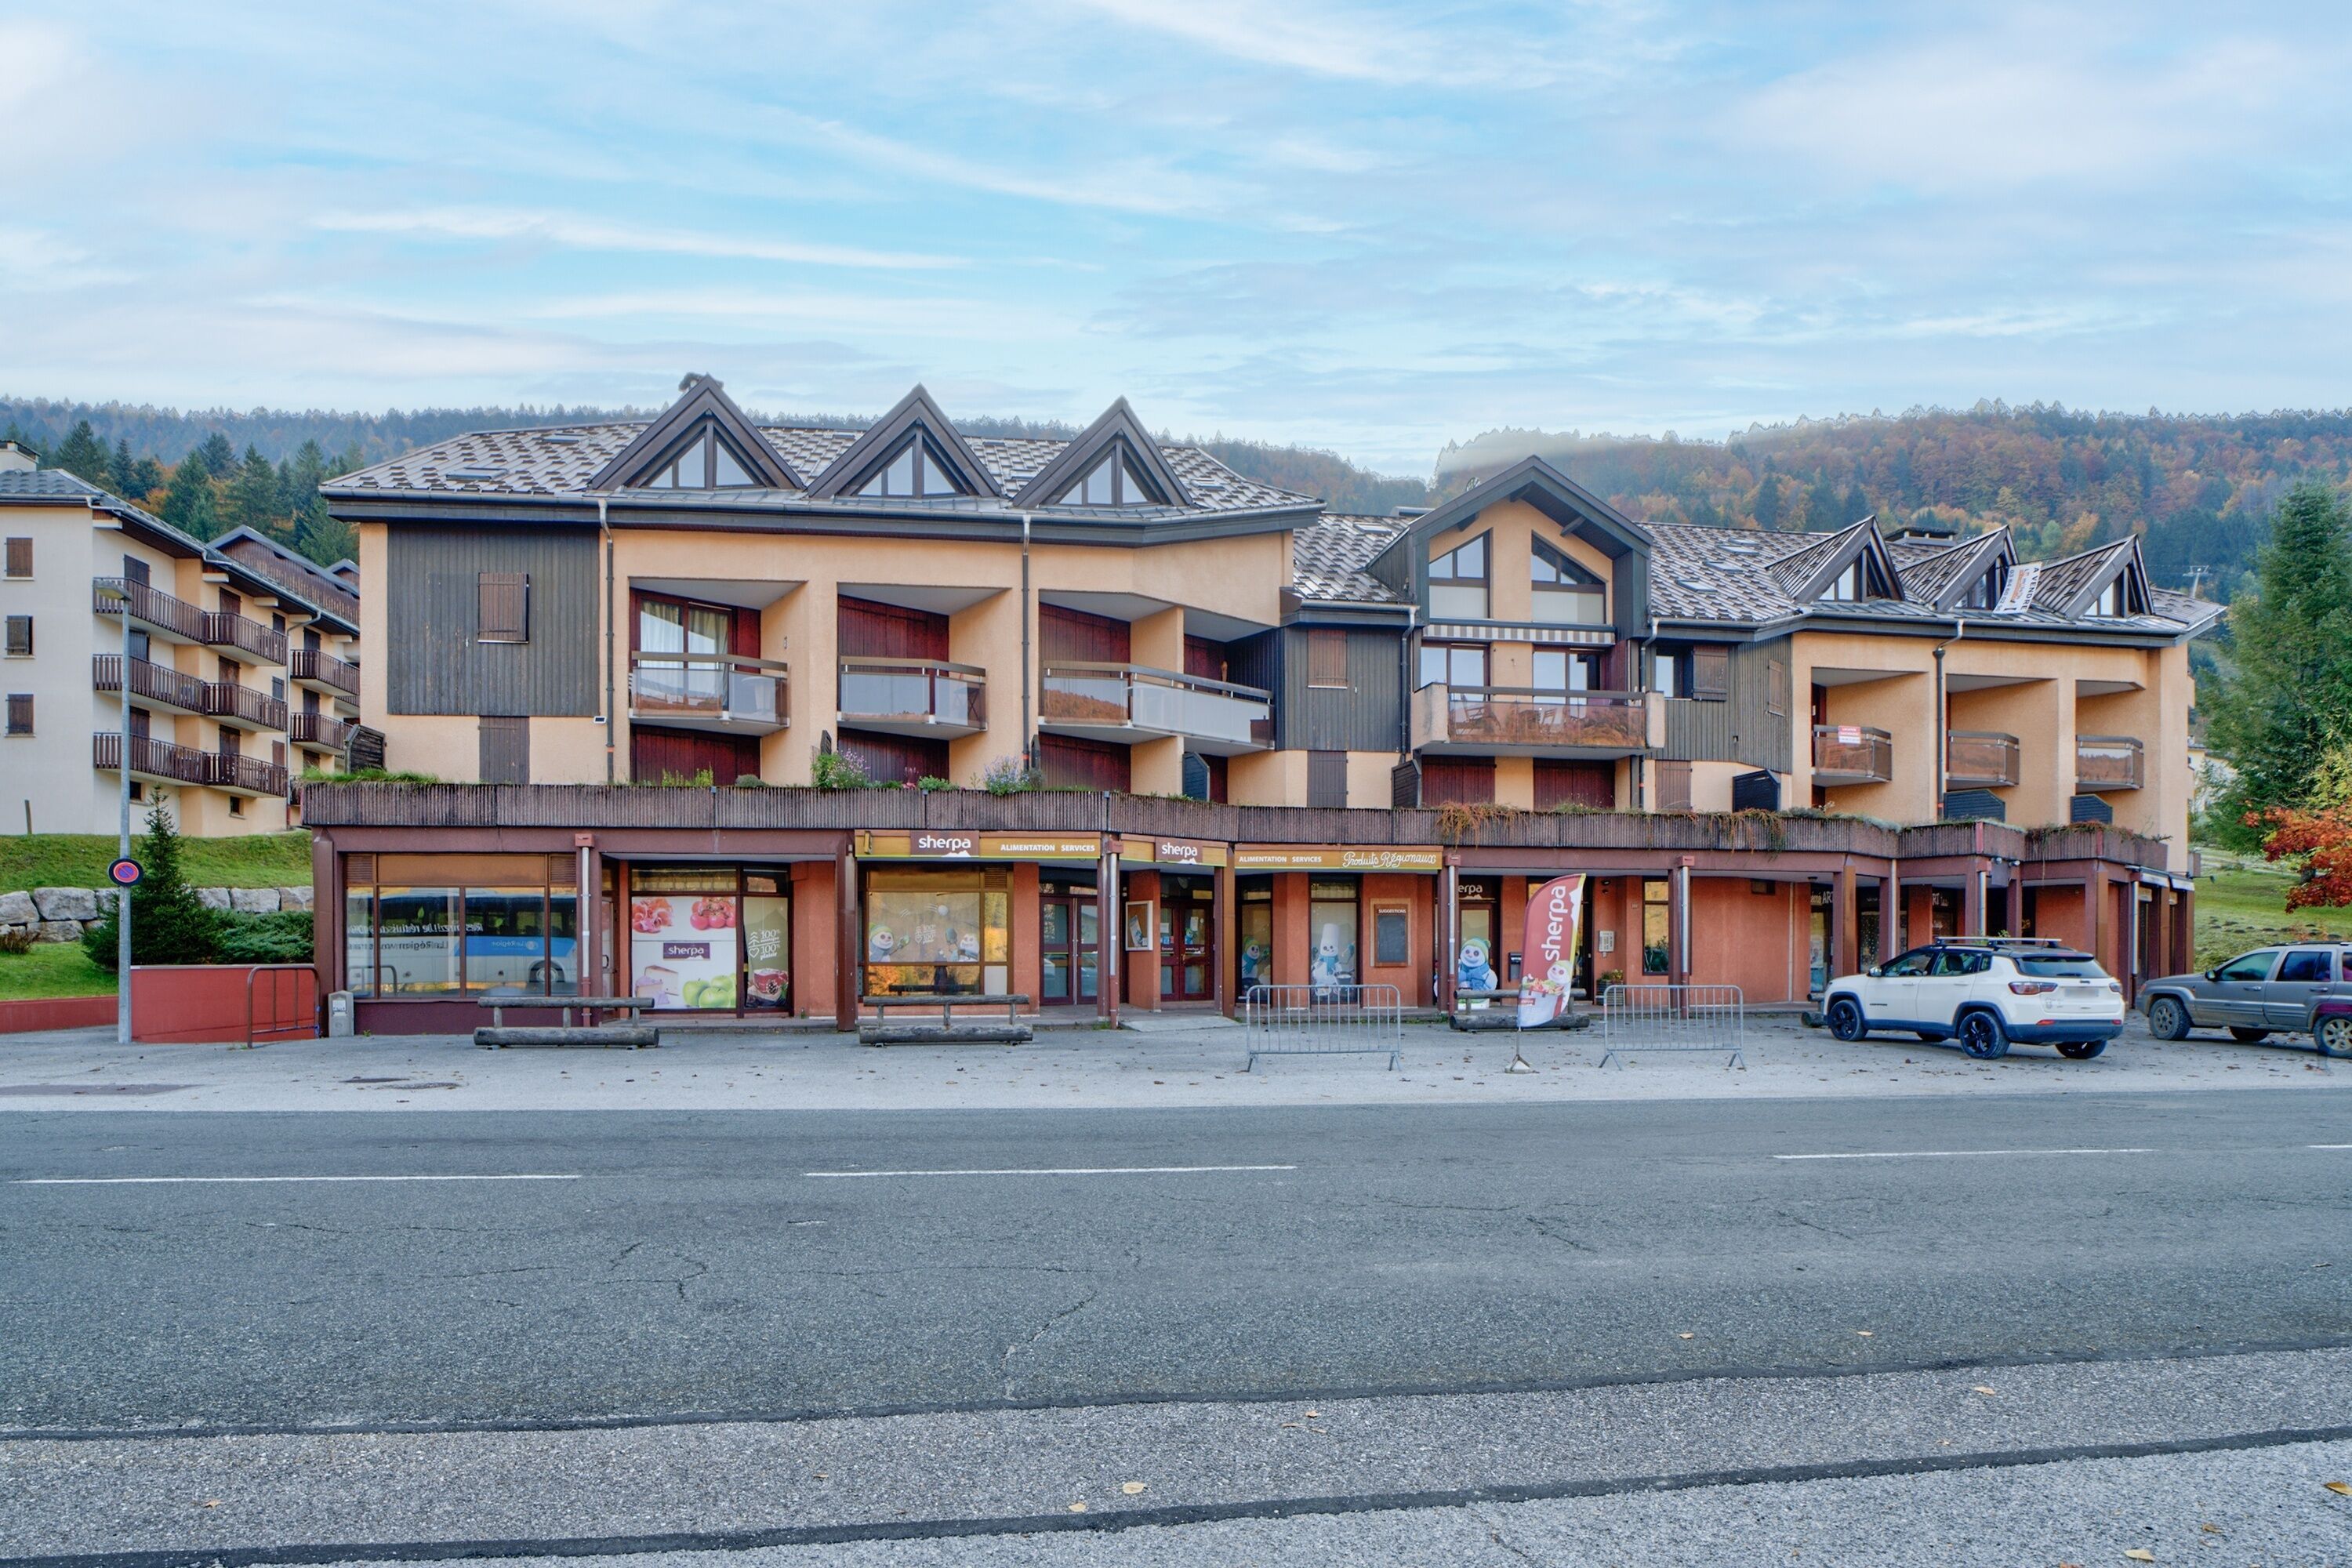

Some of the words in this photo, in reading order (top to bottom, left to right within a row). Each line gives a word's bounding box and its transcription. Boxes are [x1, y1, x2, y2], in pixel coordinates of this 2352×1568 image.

[2020, 575, 2038, 610] VENDRE
[918, 835, 971, 851] sherpa
[1161, 842, 1198, 858] sherpa
[1342, 851, 1379, 868] Produits
[1375, 851, 1437, 868] Régionaux
[1458, 884, 1483, 895] erpa
[1541, 885, 1569, 961] sherpa
[668, 946, 704, 956] sherpa
